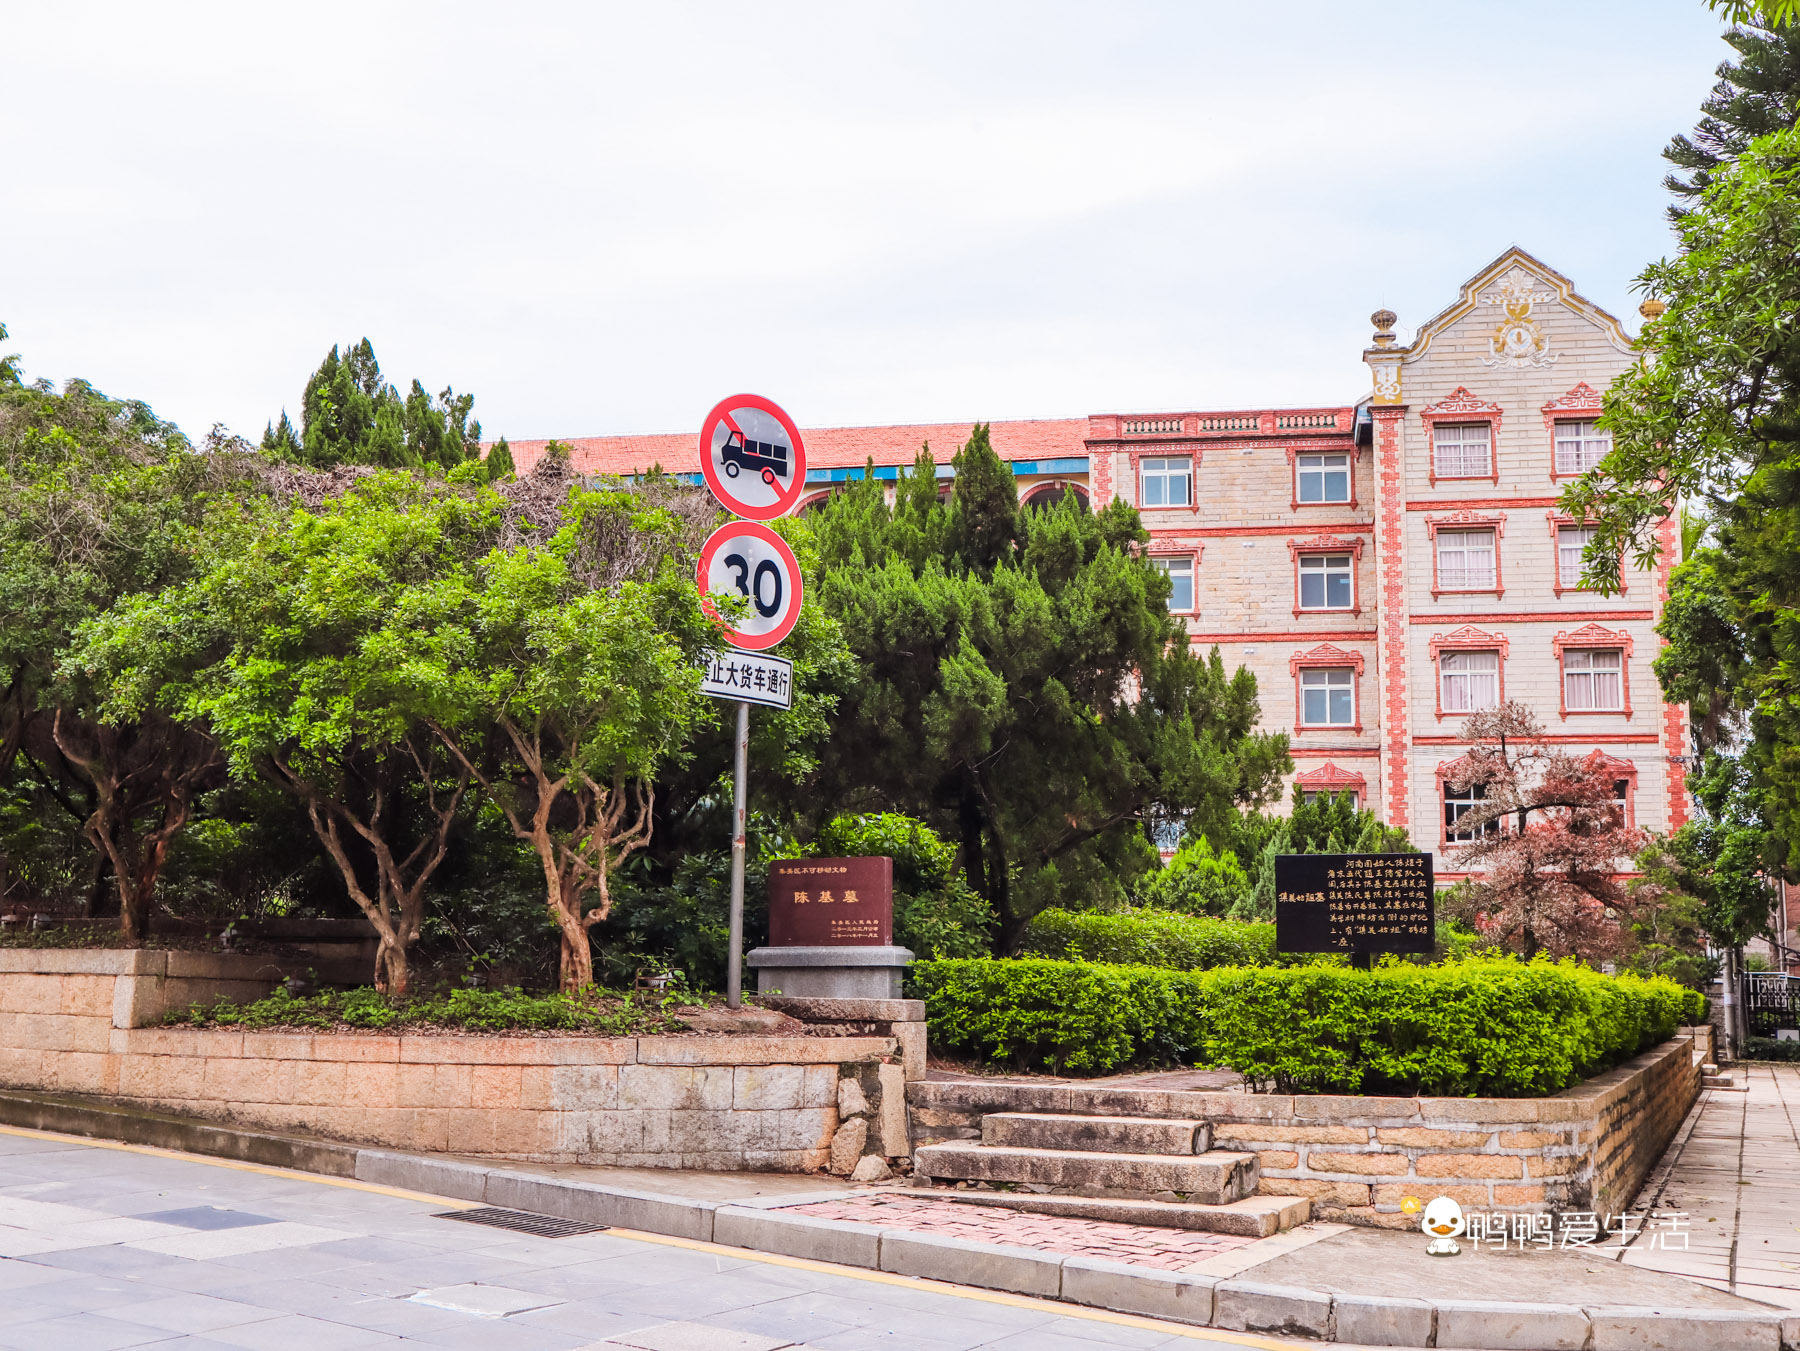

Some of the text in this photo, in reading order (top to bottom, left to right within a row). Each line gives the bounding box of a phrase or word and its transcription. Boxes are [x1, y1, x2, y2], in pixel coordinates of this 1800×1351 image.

[723, 553, 783, 619] 30
[793, 890, 860, 904] 陈基墓
